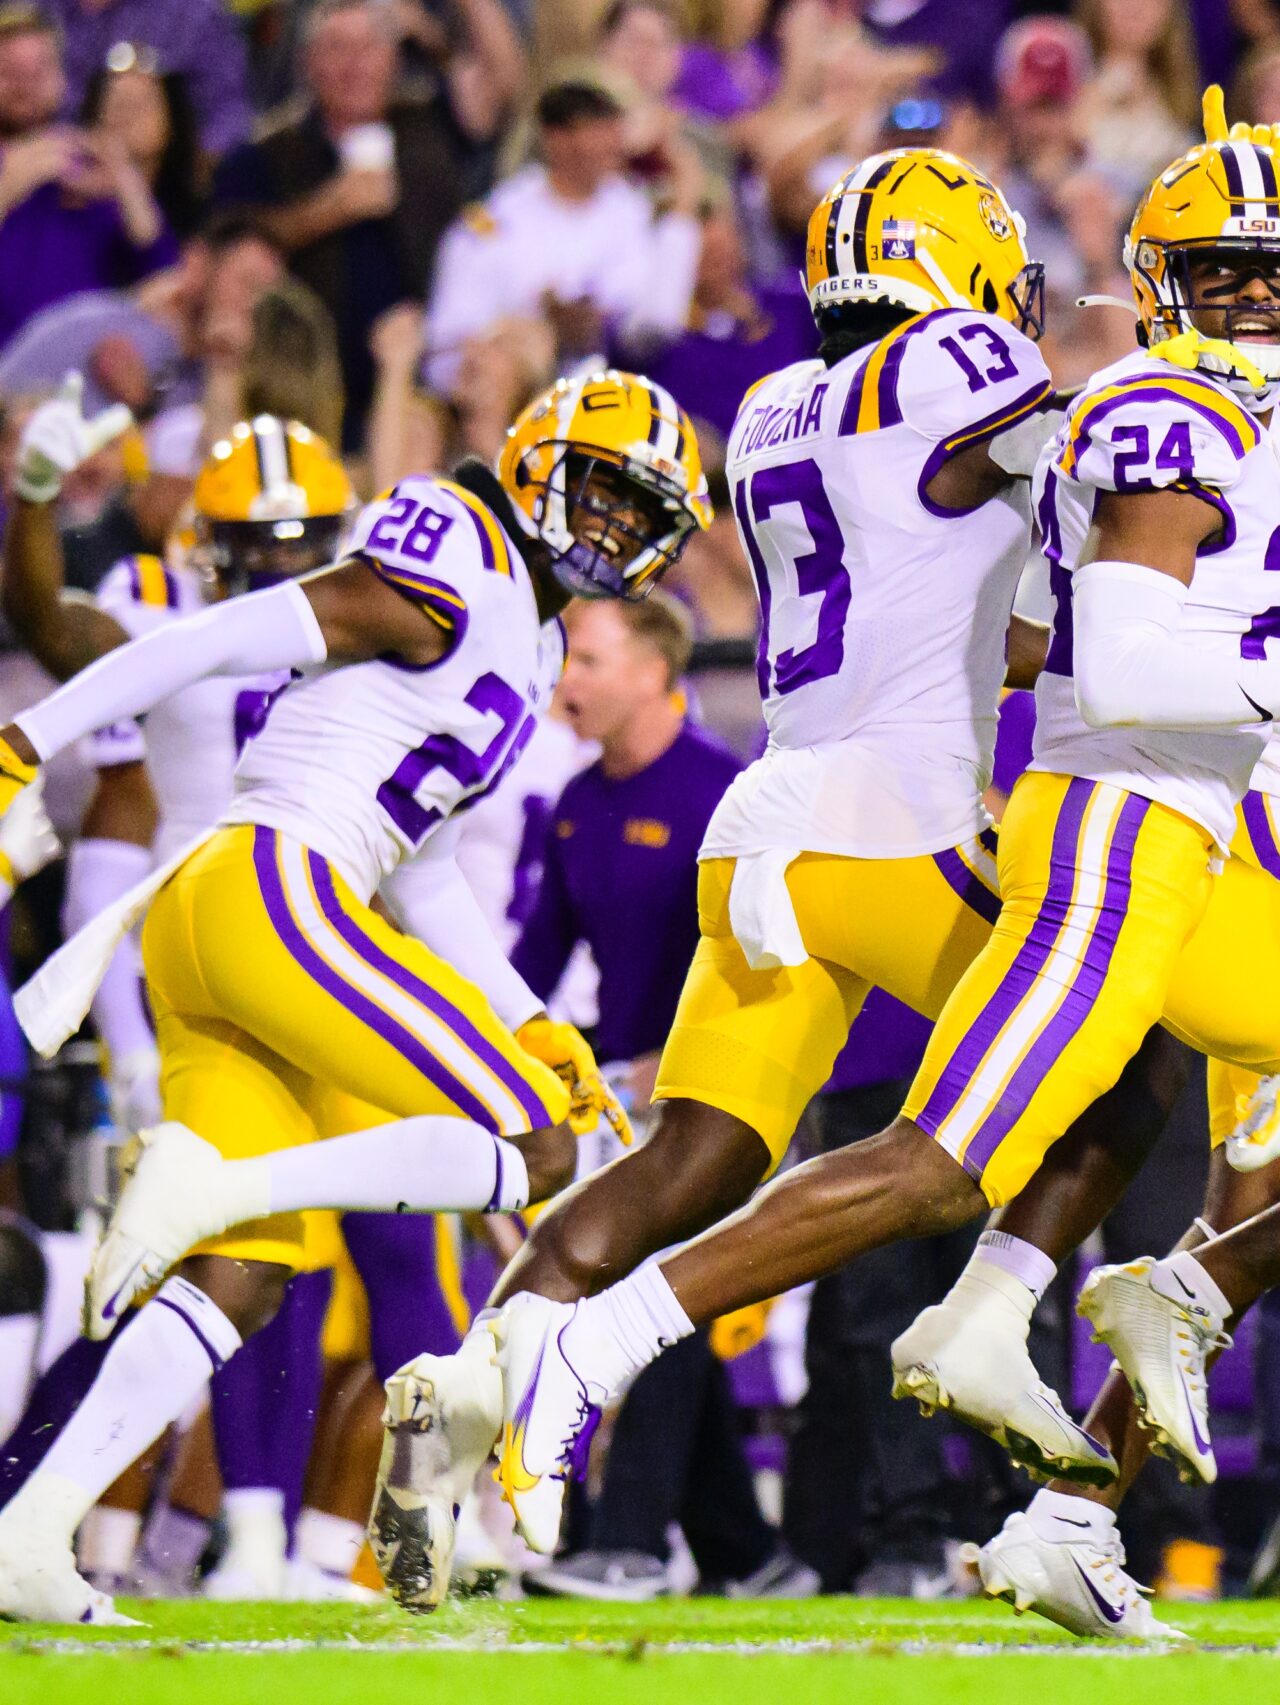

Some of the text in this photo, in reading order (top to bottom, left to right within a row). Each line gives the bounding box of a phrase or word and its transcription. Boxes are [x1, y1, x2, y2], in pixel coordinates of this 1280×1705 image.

[871, 245, 878, 260] 3
[1239, 219, 1276, 232] LSU
[817, 278, 878, 296] TIGERS
[939, 322, 1019, 394] 13
[1111, 421, 1195, 493] 24
[366, 498, 454, 563] 28
[736, 457, 852, 700] 13
[376, 671, 538, 846] 2
